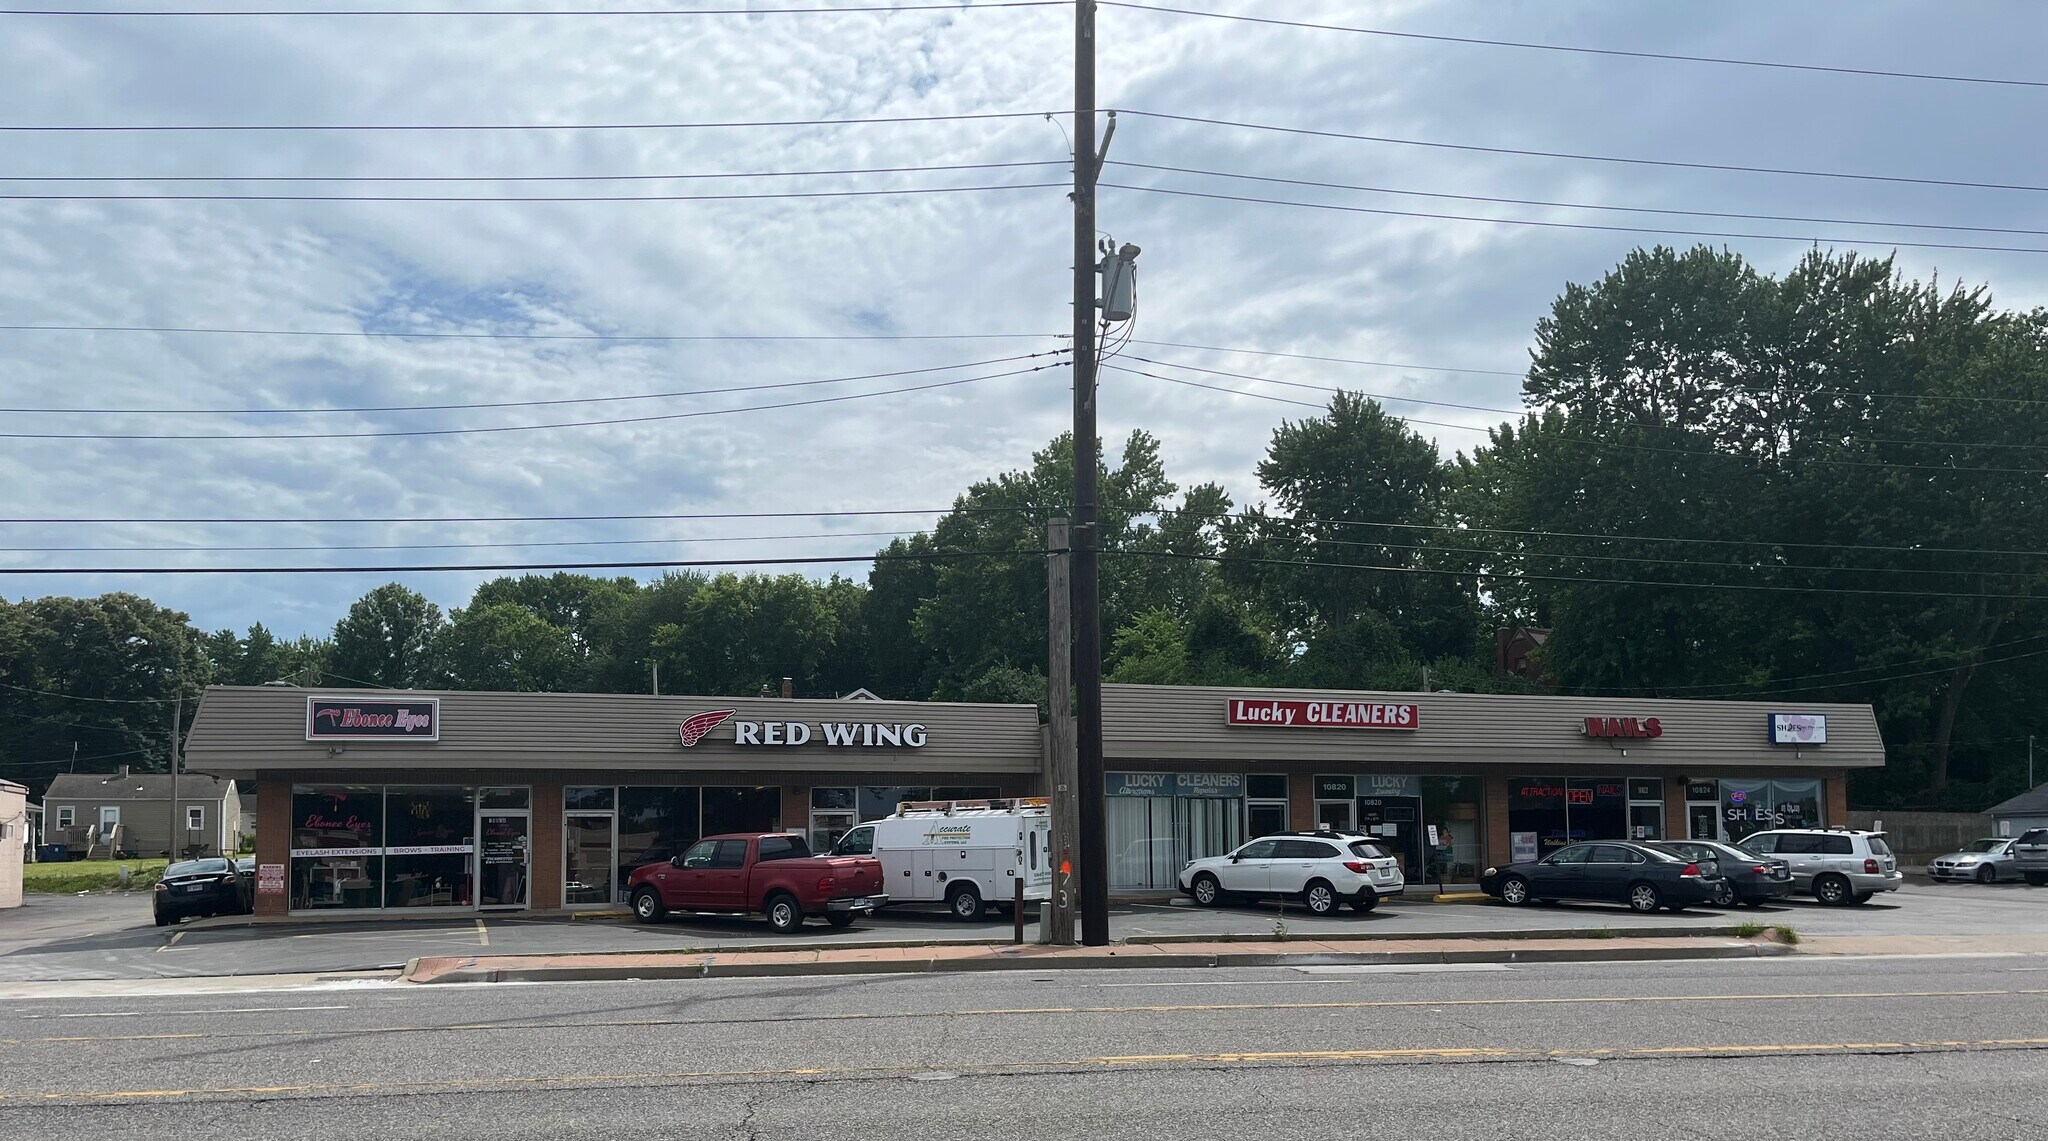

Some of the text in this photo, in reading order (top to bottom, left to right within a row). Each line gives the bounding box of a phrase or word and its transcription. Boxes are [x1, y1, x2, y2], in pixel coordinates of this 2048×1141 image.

[1236, 700, 1411, 725] Lucky CLEANERS
[340, 708, 430, 733] Ebonee Eyes
[1583, 715, 1663, 738] NAILS
[734, 721, 927, 747] RED WING
[1124, 773, 1240, 787] LUCKY CLEANERS
[1322, 783, 1347, 791] 10820
[1371, 776, 1408, 788] LUCKY
[1520, 786, 1564, 797] ATTRACTION
[1567, 790, 1593, 803] OPEN
[345, 815, 372, 833] Eyes
[295, 849, 330, 857] EYELASH
